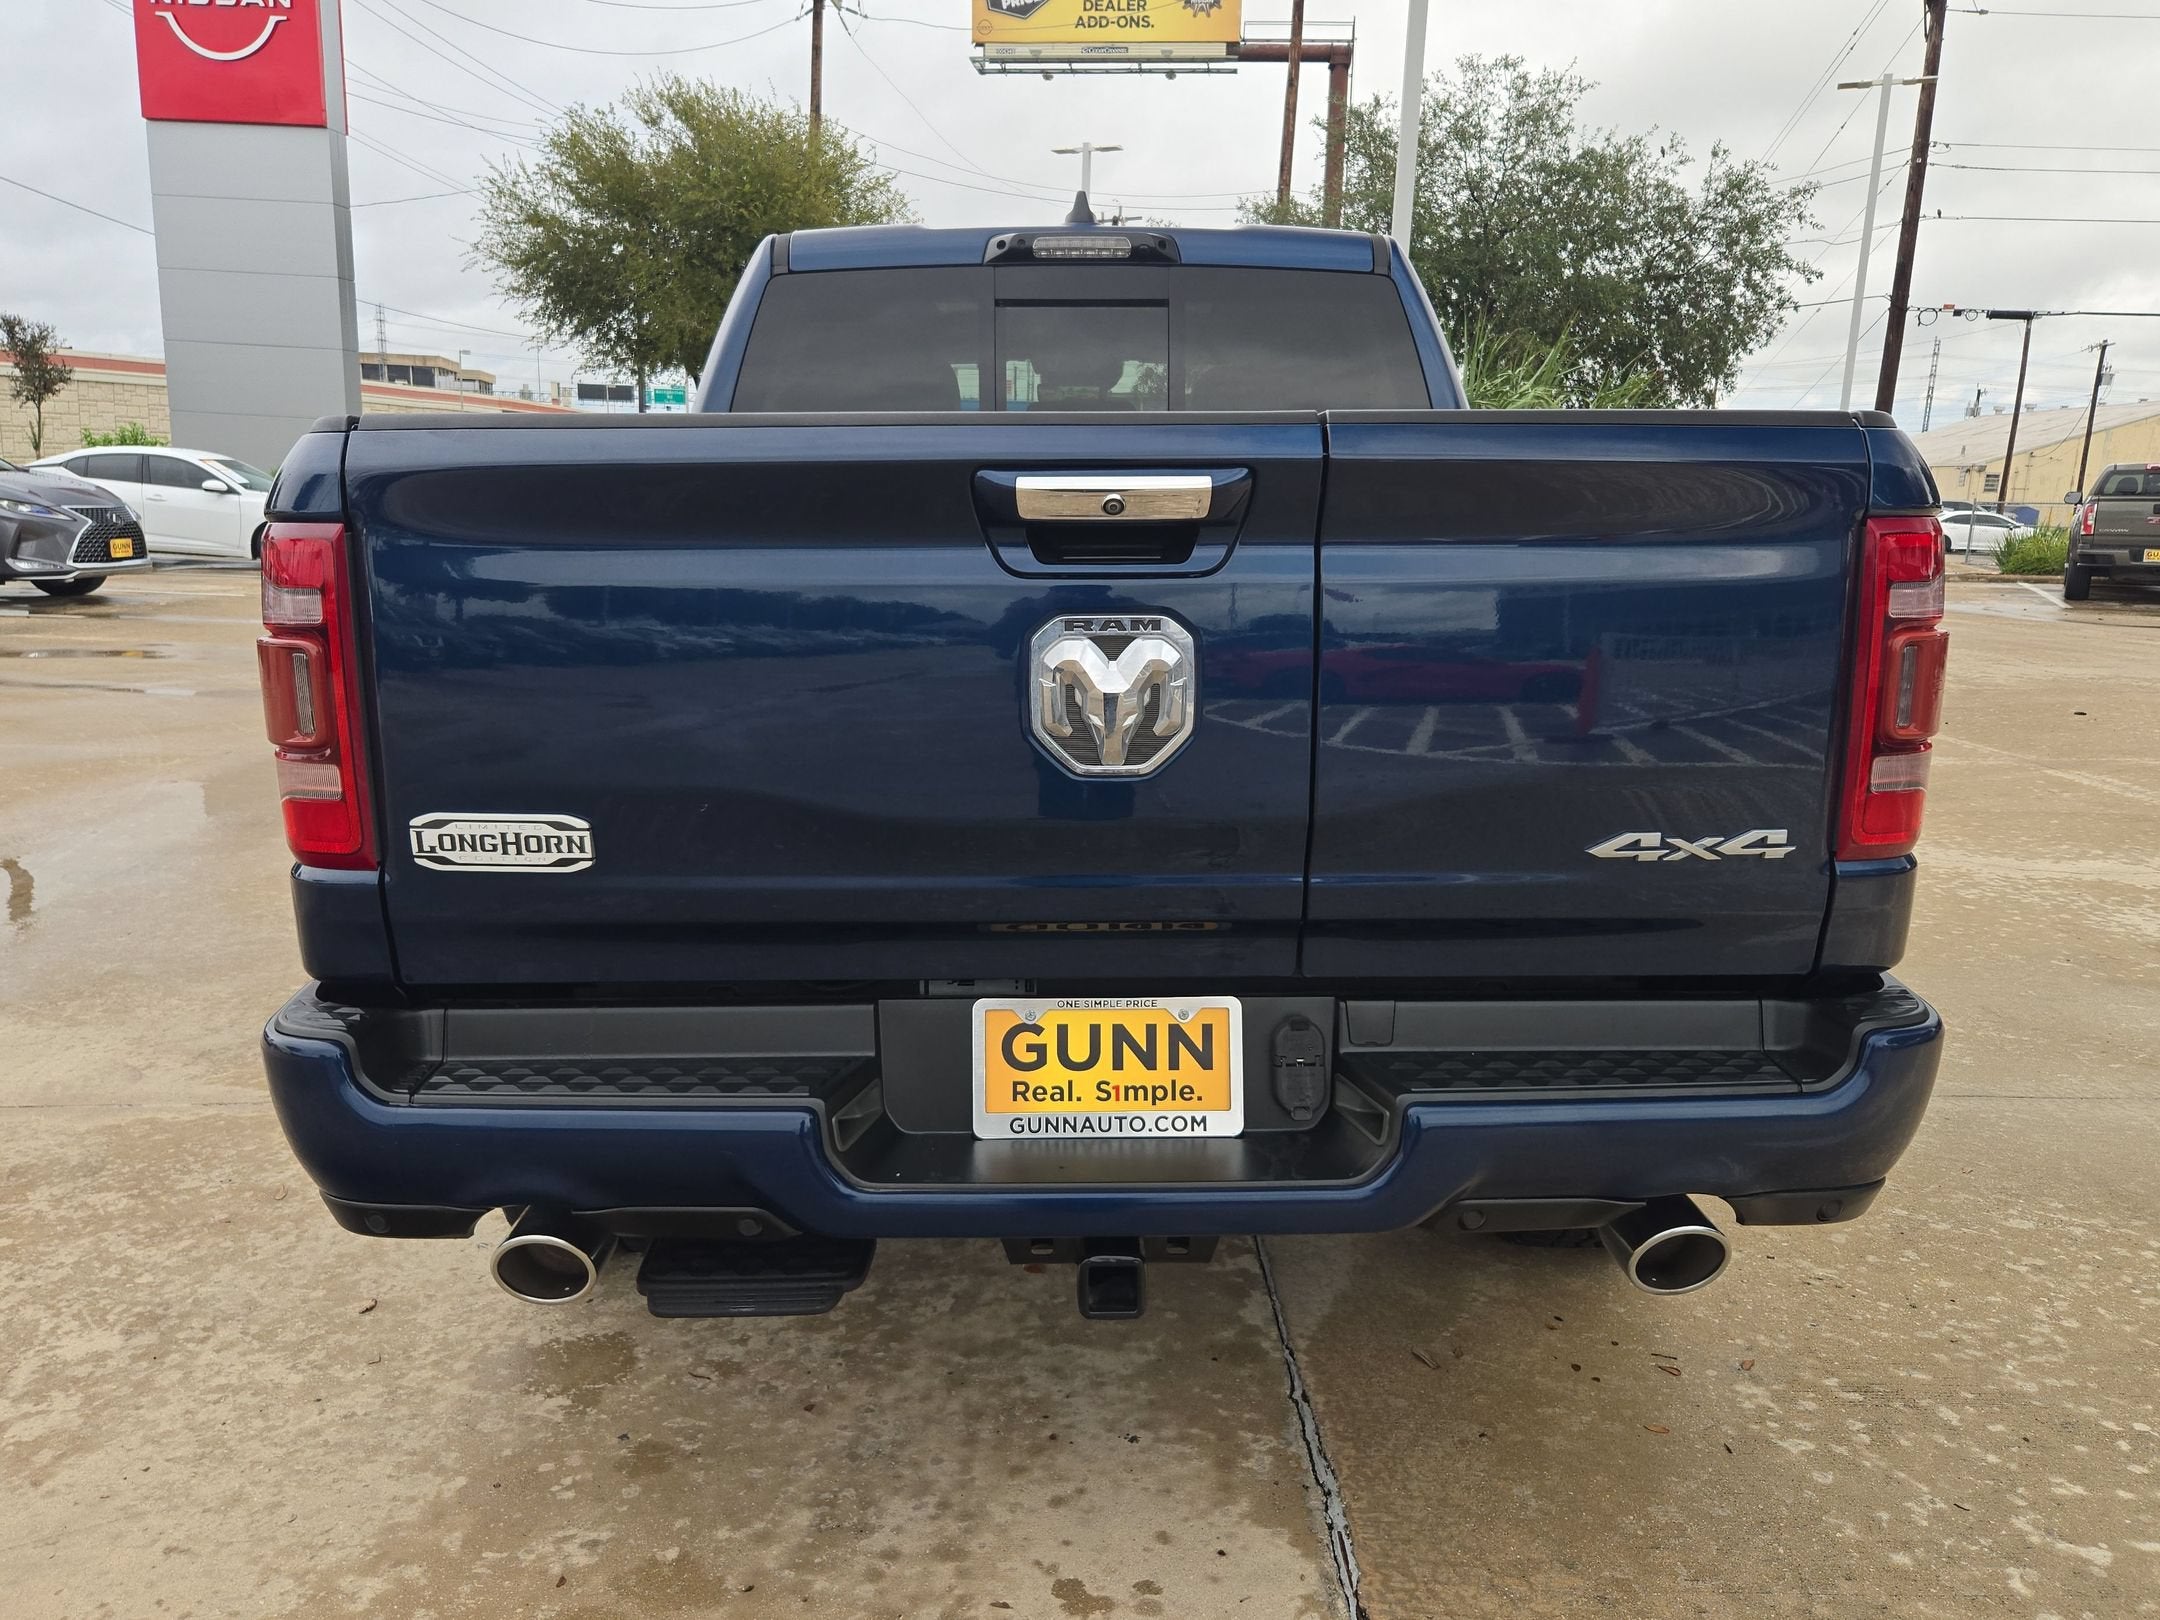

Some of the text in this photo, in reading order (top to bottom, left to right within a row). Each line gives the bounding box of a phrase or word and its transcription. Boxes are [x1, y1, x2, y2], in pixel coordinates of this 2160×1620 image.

[1083, 0, 1147, 11] DEALER
[1075, 15, 1154, 28] ADD-ONS.
[1064, 619, 1162, 632] RAM
[414, 830, 589, 856] LONGHORN
[1585, 829, 1796, 862] 4x4
[1057, 1000, 1158, 1008] ONE SIMPLE PRICE
[1001, 1022, 1214, 1072] GUNN
[1012, 1080, 1082, 1102] Real.
[1010, 1115, 1208, 1134] GUNNAUTO.COM
